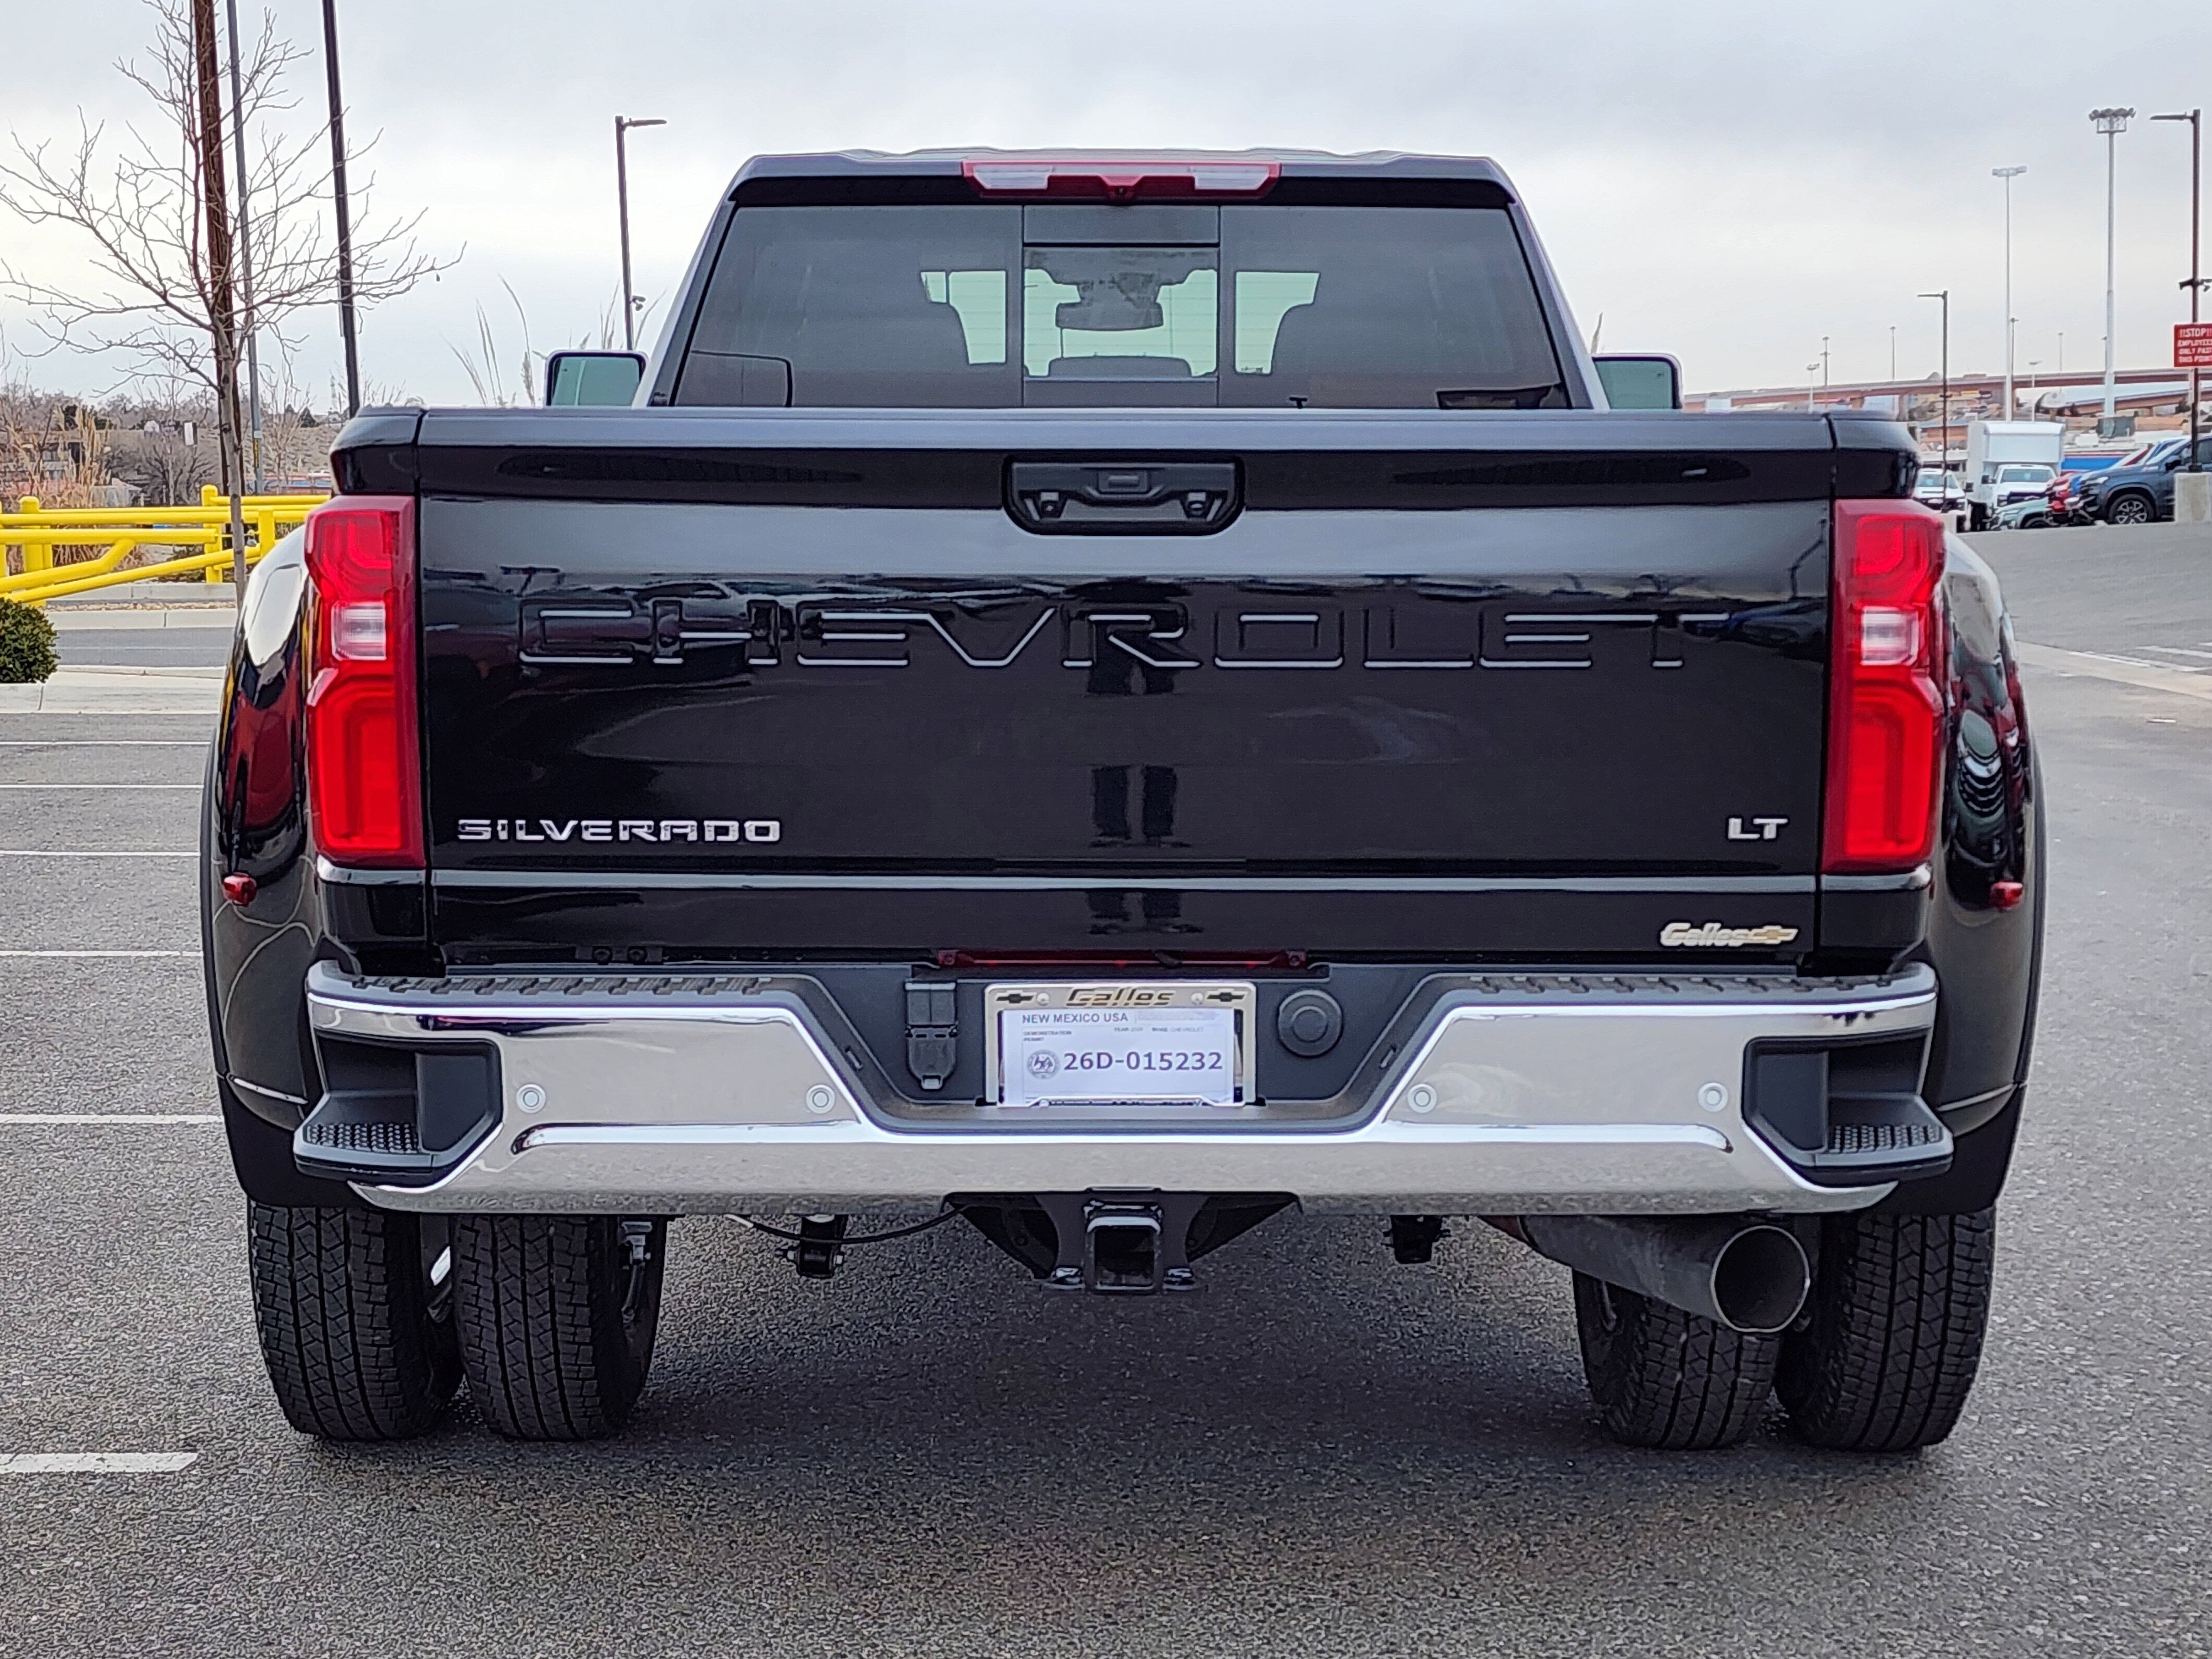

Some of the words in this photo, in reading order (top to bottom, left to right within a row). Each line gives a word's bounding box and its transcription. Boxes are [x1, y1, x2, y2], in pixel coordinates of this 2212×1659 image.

[519, 598, 1730, 667] CHEVROLET
[457, 819, 781, 842] SILVERADO
[1728, 817, 1788, 839] LT
[1065, 987, 1176, 1007] Galles
[1022, 1014, 1050, 1024] NEW
[1053, 1013, 1100, 1023] MEXICO
[1103, 1013, 1129, 1022] USA
[1063, 1051, 1223, 1071] 26D-015232
